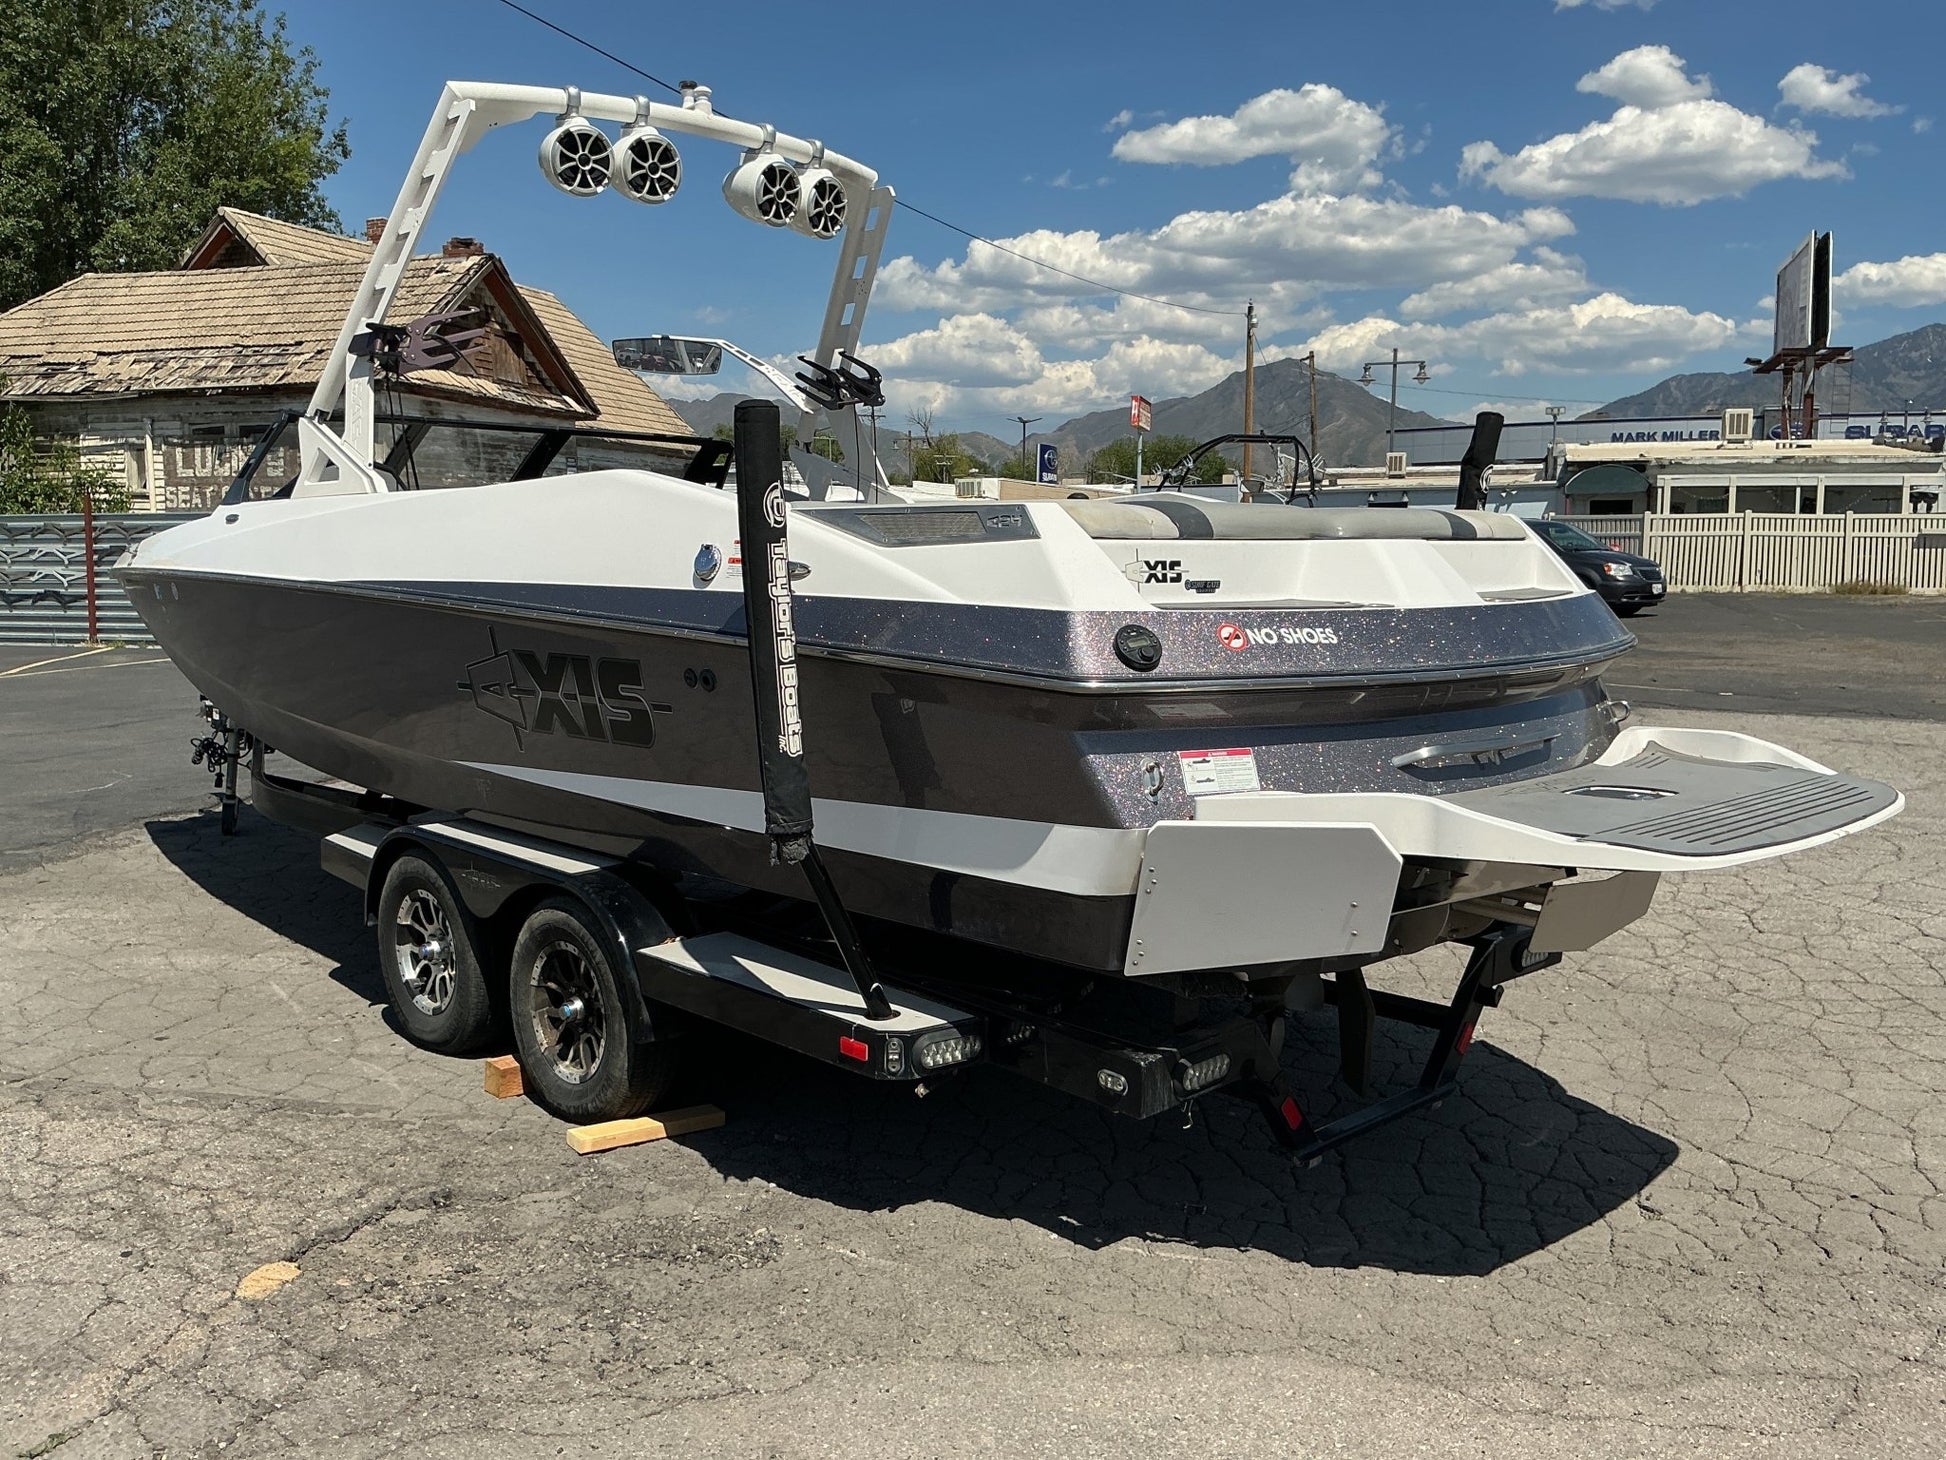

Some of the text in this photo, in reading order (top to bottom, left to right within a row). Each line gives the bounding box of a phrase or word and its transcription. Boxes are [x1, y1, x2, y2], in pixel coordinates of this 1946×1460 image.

[1611, 430, 1720, 442] MARK MILLER
[1845, 424, 1946, 441] SUBAR
[165, 486, 213, 508] SEAT
[1245, 627, 1338, 645] NO SHOES
[769, 538, 803, 757] Taylor's Boats
